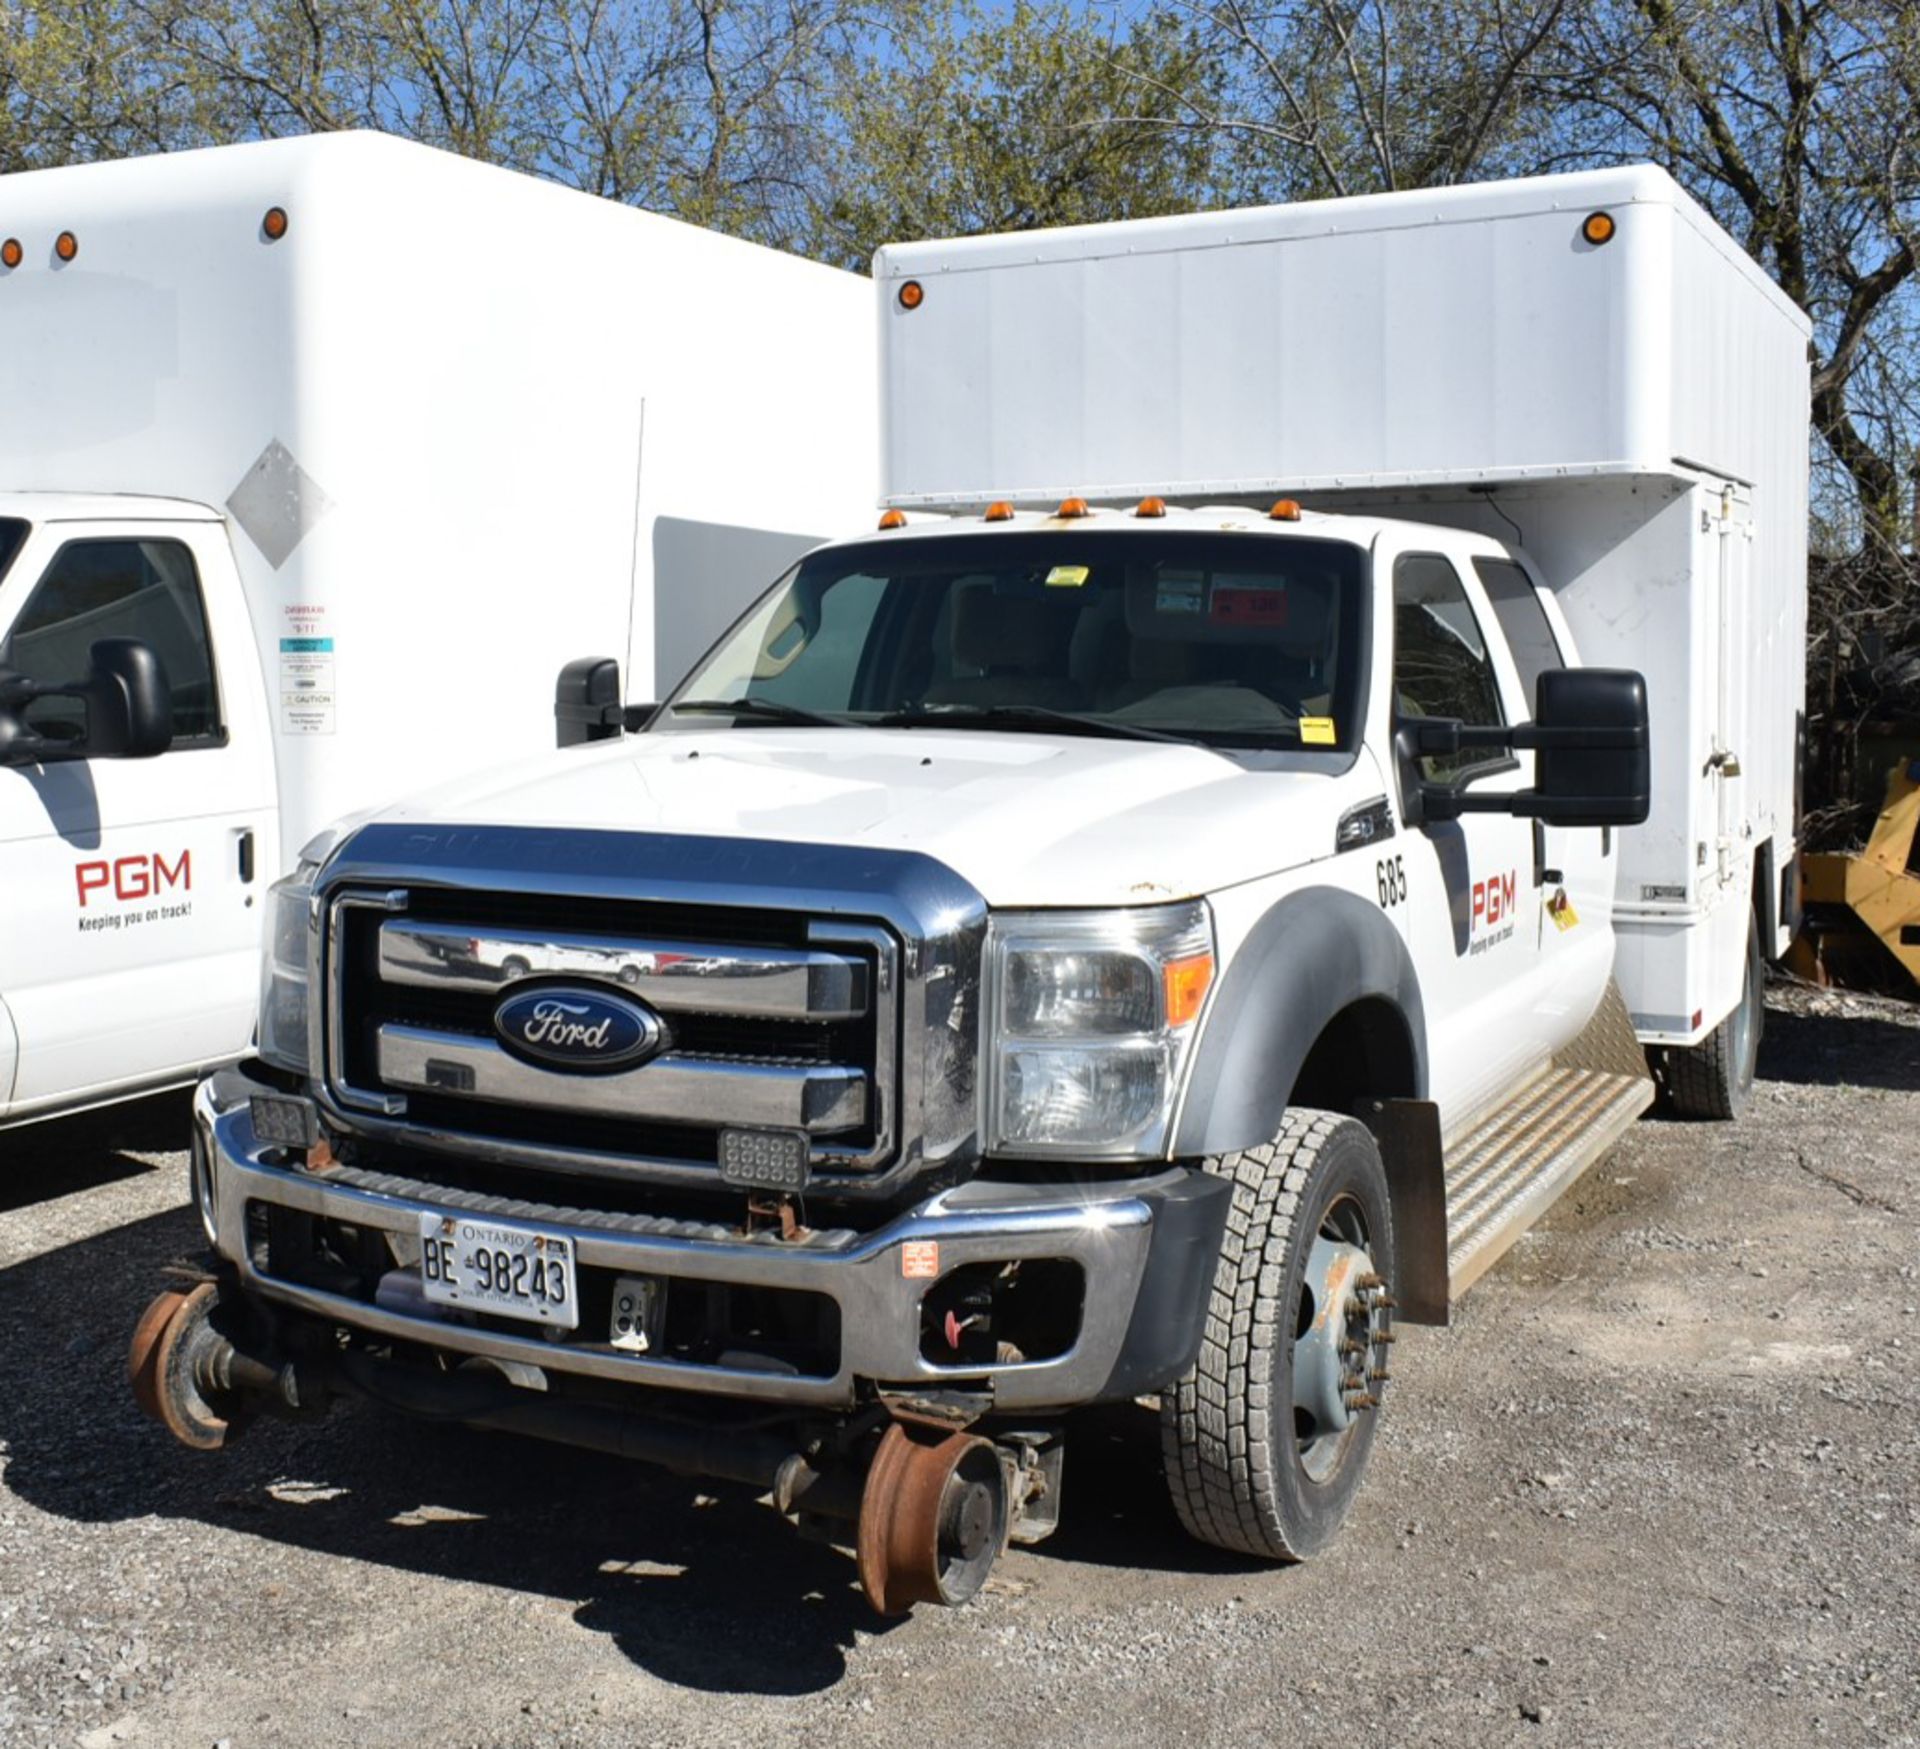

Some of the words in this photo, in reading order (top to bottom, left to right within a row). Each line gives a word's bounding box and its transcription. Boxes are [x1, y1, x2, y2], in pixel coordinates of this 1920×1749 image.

[294, 695, 331, 704] CAUTION
[75, 849, 191, 908] PGM
[1376, 855, 1407, 909] 685
[1471, 869, 1516, 932] PGM
[78, 913, 121, 932] Keeping
[123, 911, 143, 927] you
[145, 909, 159, 922] on
[160, 901, 191, 919] track!
[524, 999, 612, 1048] Ford
[462, 1226, 526, 1247] ONTARIO
[423, 1238, 460, 1285] BE
[475, 1247, 566, 1304] 98243
